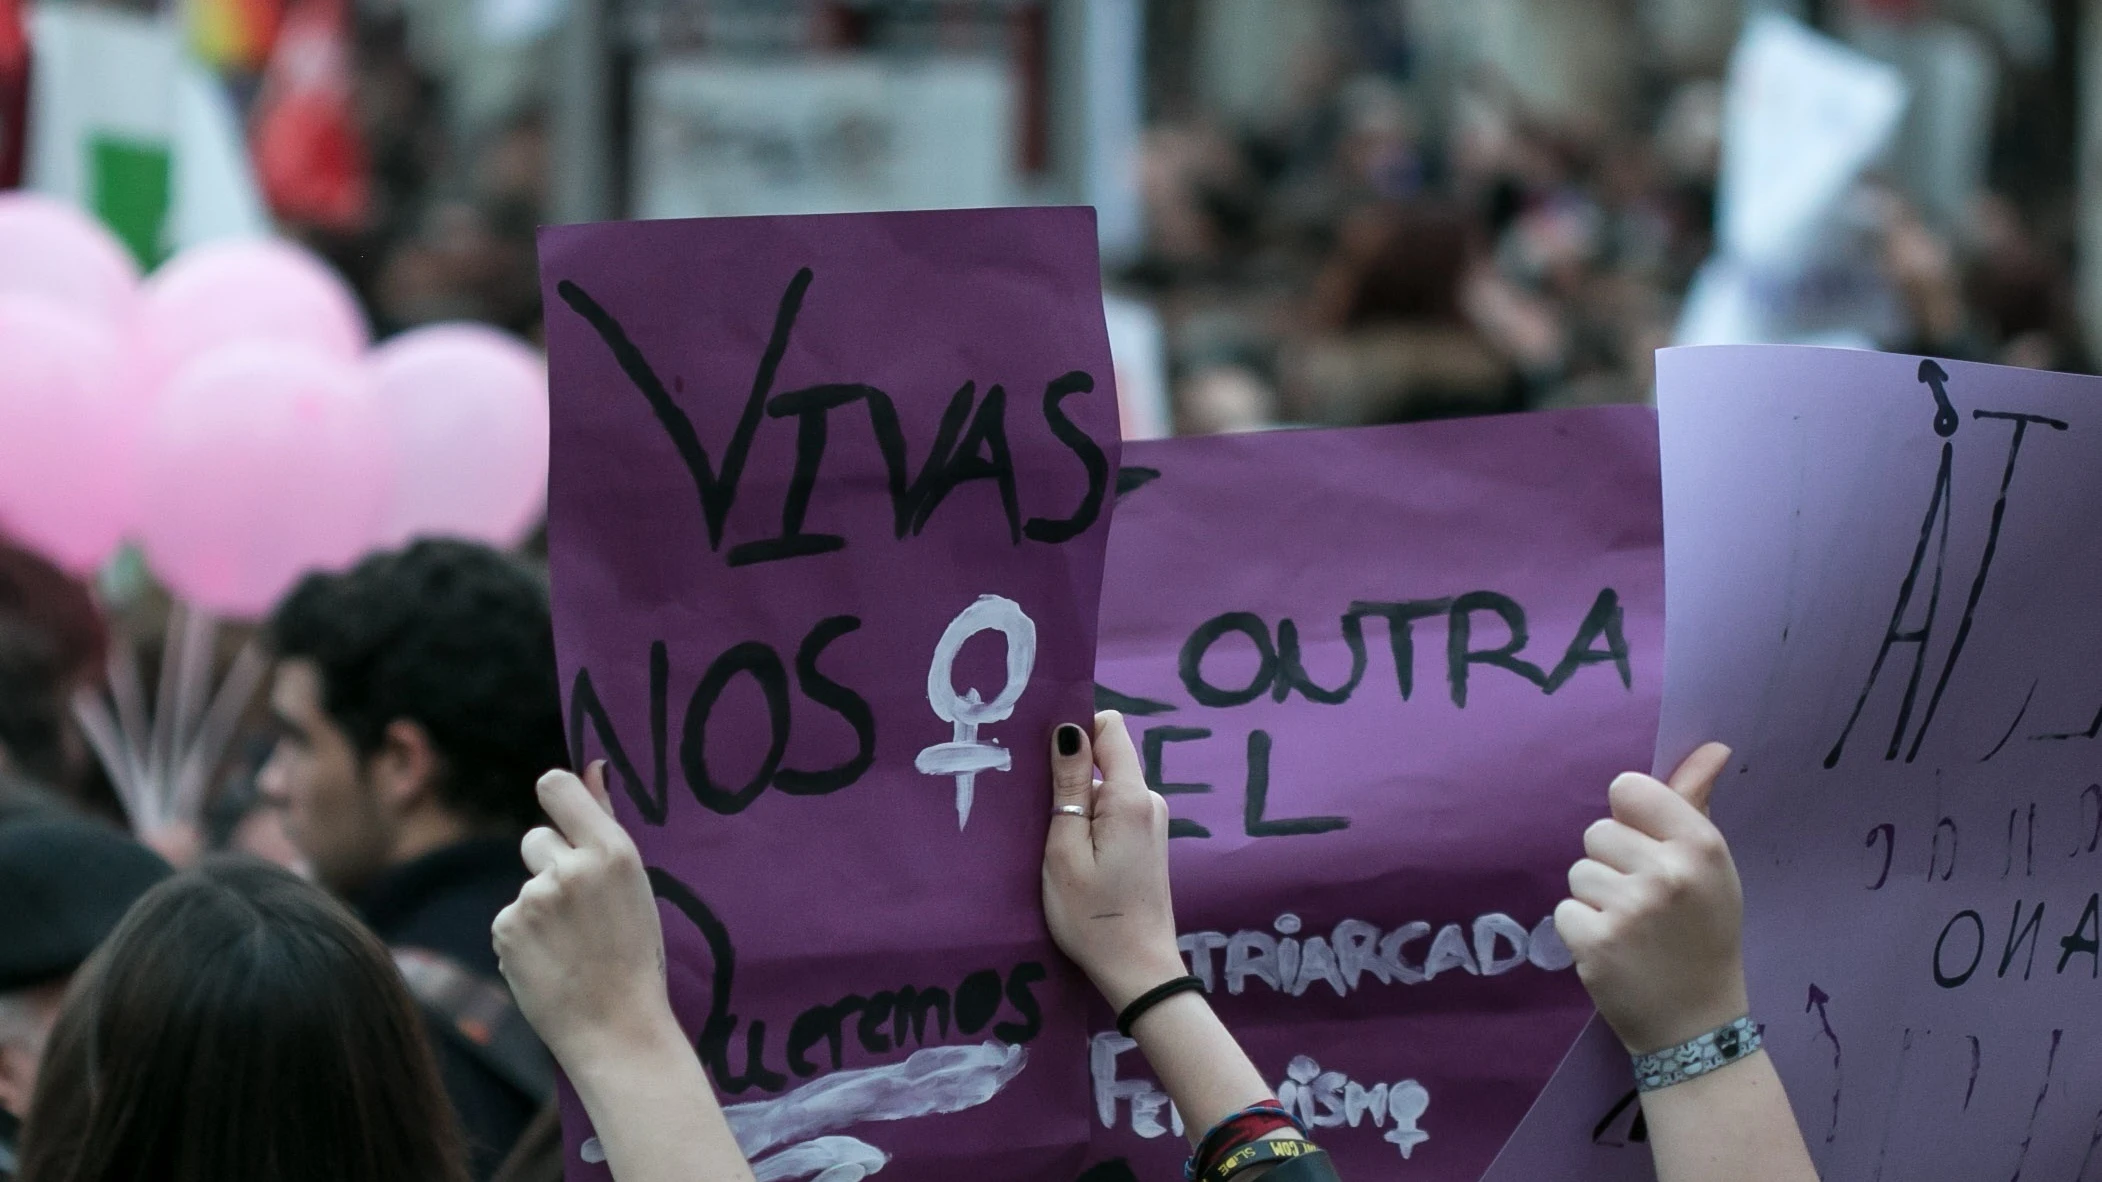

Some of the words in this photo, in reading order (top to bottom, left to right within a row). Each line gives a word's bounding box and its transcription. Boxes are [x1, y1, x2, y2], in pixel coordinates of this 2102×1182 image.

[558, 266, 1109, 568] VIVAS
[568, 614, 876, 827] NOS
[1094, 587, 1634, 716] ONTRA
[1143, 725, 1351, 838] EL
